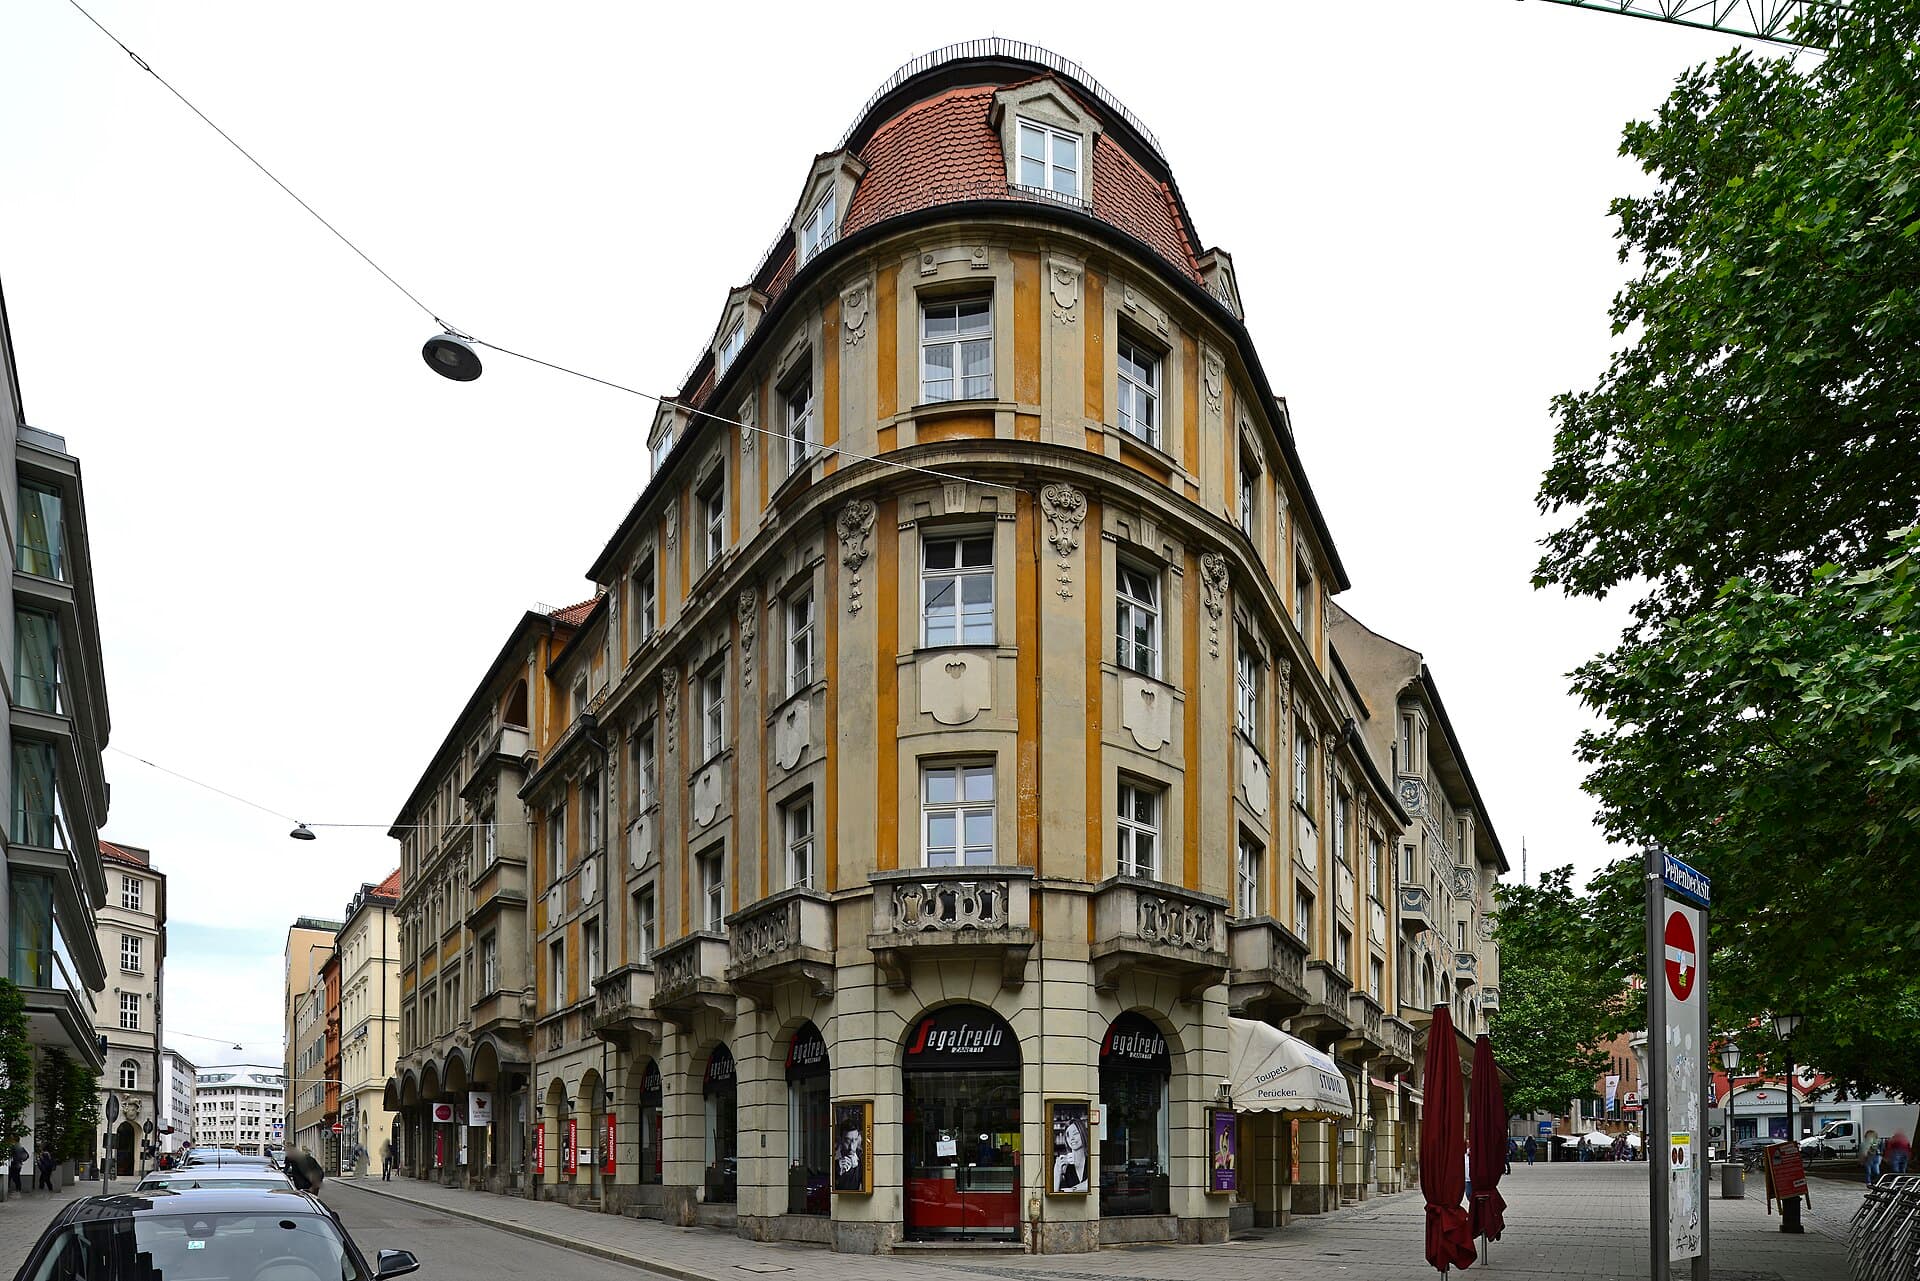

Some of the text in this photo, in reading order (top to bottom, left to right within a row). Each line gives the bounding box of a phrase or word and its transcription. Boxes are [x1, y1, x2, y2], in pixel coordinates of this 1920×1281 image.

[908, 1019, 1003, 1054] Segafredo
[1100, 1024, 1164, 1056] Segafredo
[1255, 1065, 1288, 1084] Toupets
[1320, 1073, 1342, 1094] STUDIO
[1257, 1088, 1297, 1098] Perücken
